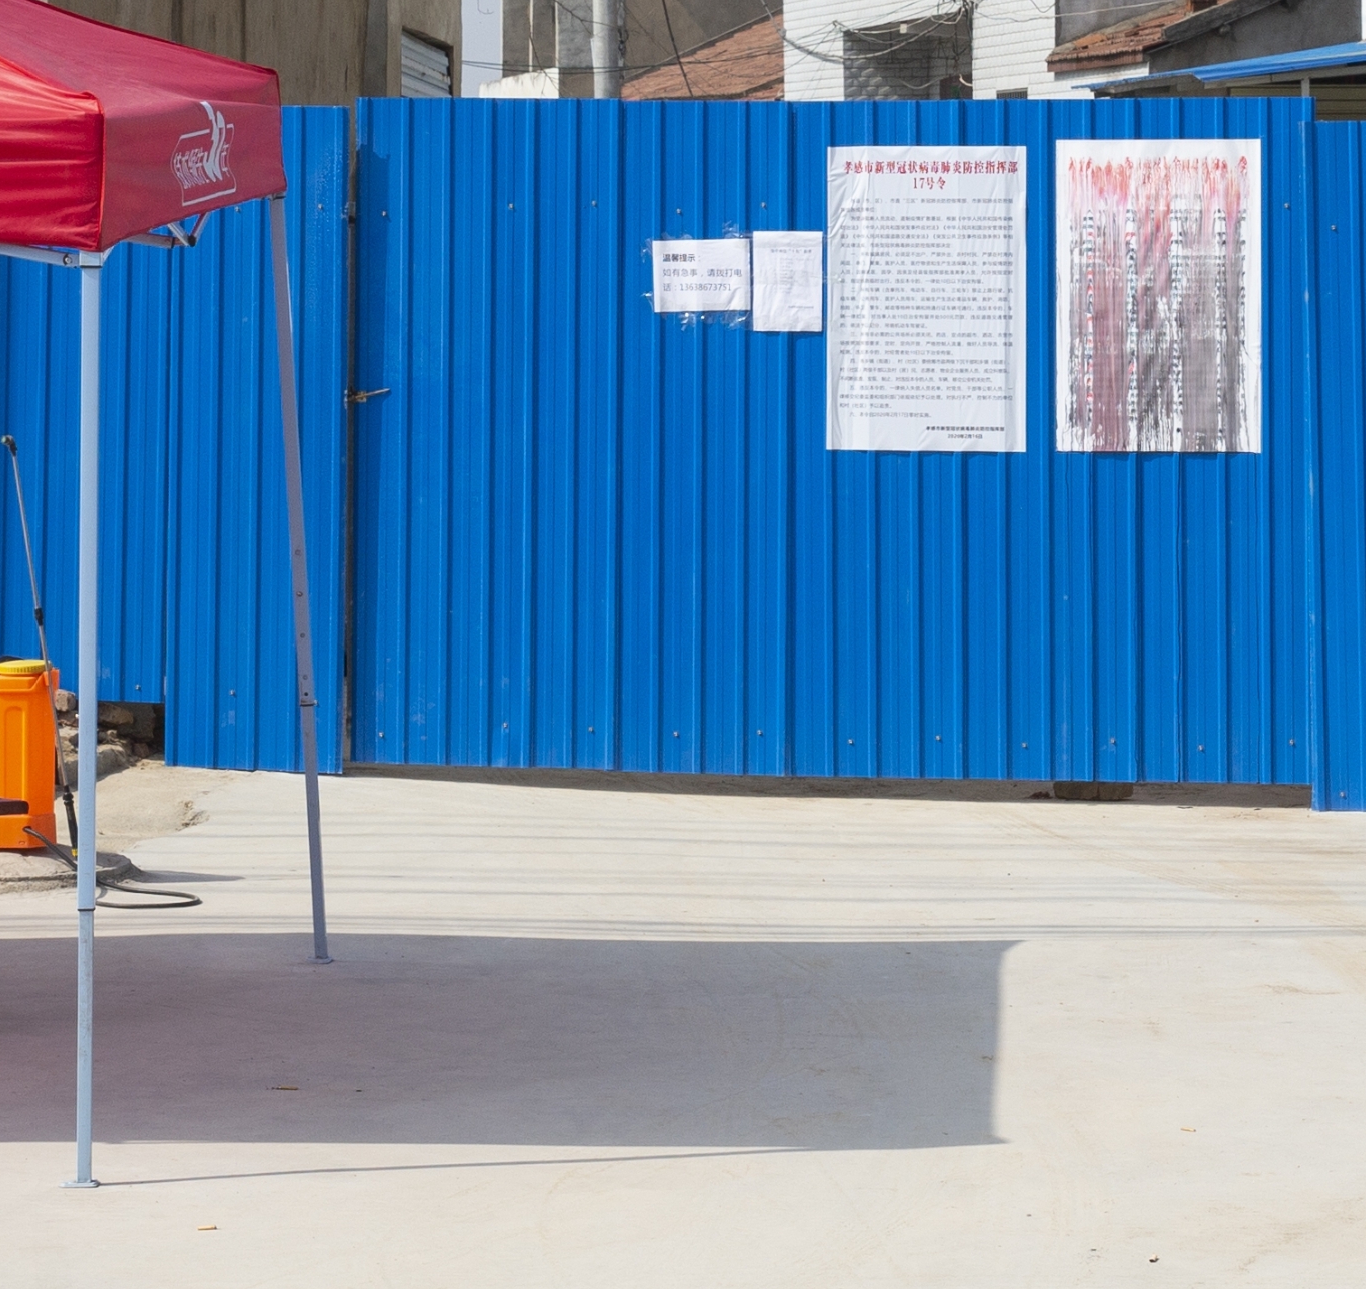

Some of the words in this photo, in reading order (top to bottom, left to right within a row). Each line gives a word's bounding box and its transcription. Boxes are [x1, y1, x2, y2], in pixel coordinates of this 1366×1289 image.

[843, 160, 1019, 175] 孝感市新型冠状病毒肺炎防控指挥部
[913, 176, 947, 191] 17号令
[662, 268, 743, 278] 如有急事，请拨打电
